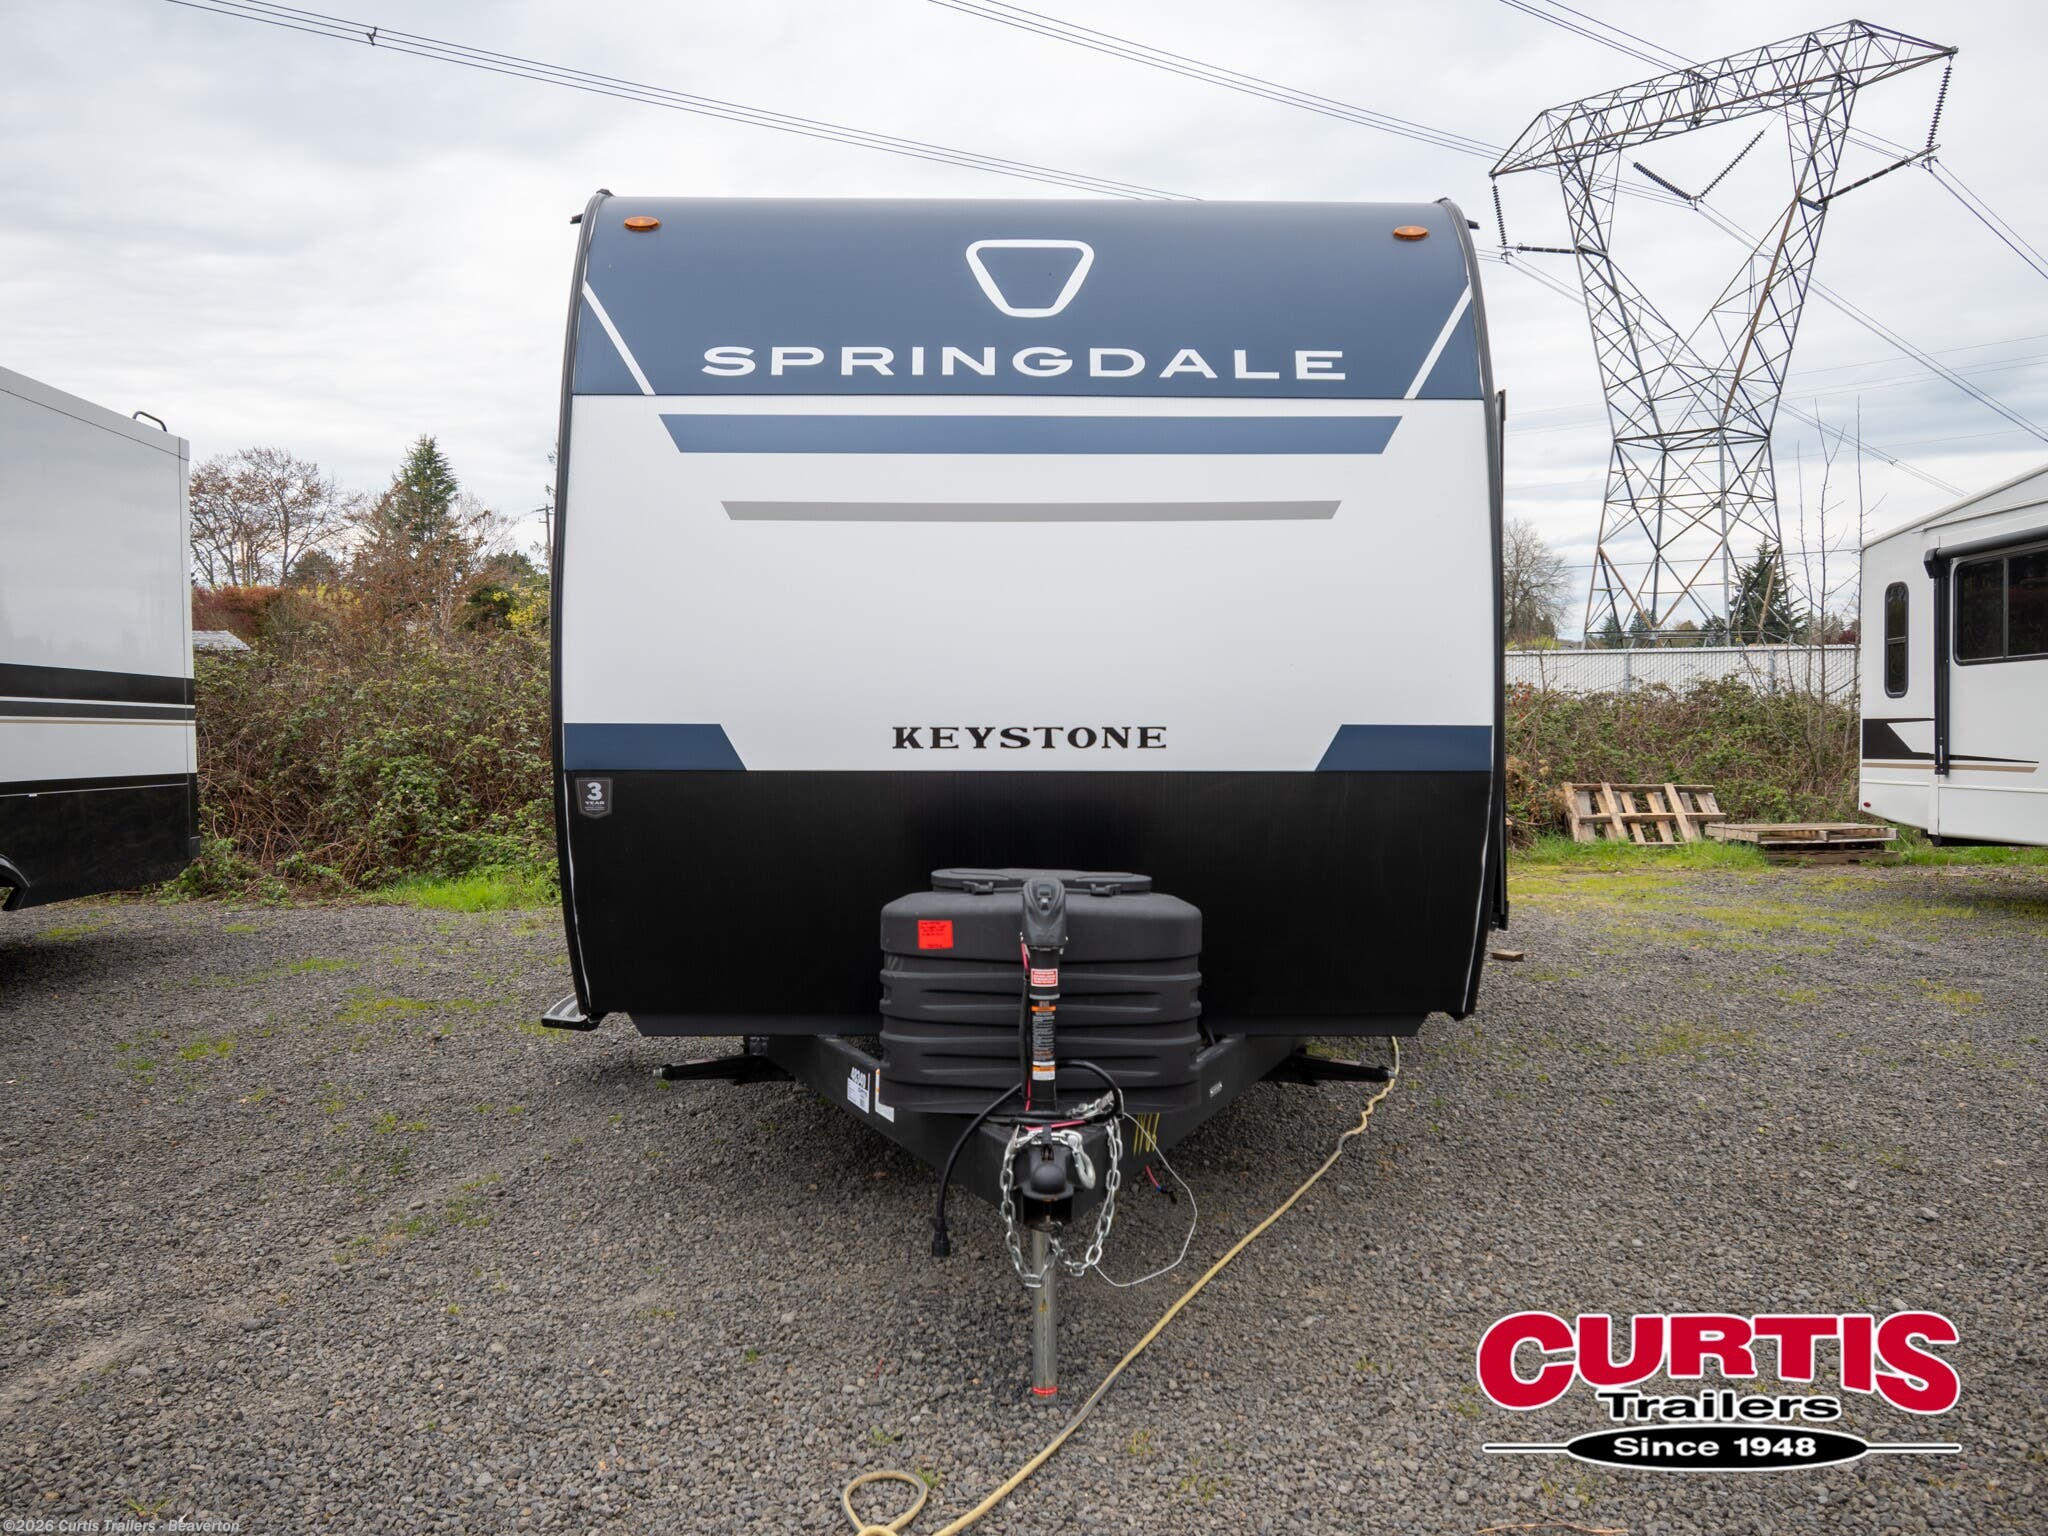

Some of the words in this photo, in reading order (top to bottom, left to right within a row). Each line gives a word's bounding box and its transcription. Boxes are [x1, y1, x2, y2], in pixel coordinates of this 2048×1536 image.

[701, 345, 1346, 380] SPRINGDALE
[892, 726, 1167, 749] KEYSTONE
[587, 782, 602, 800] 3
